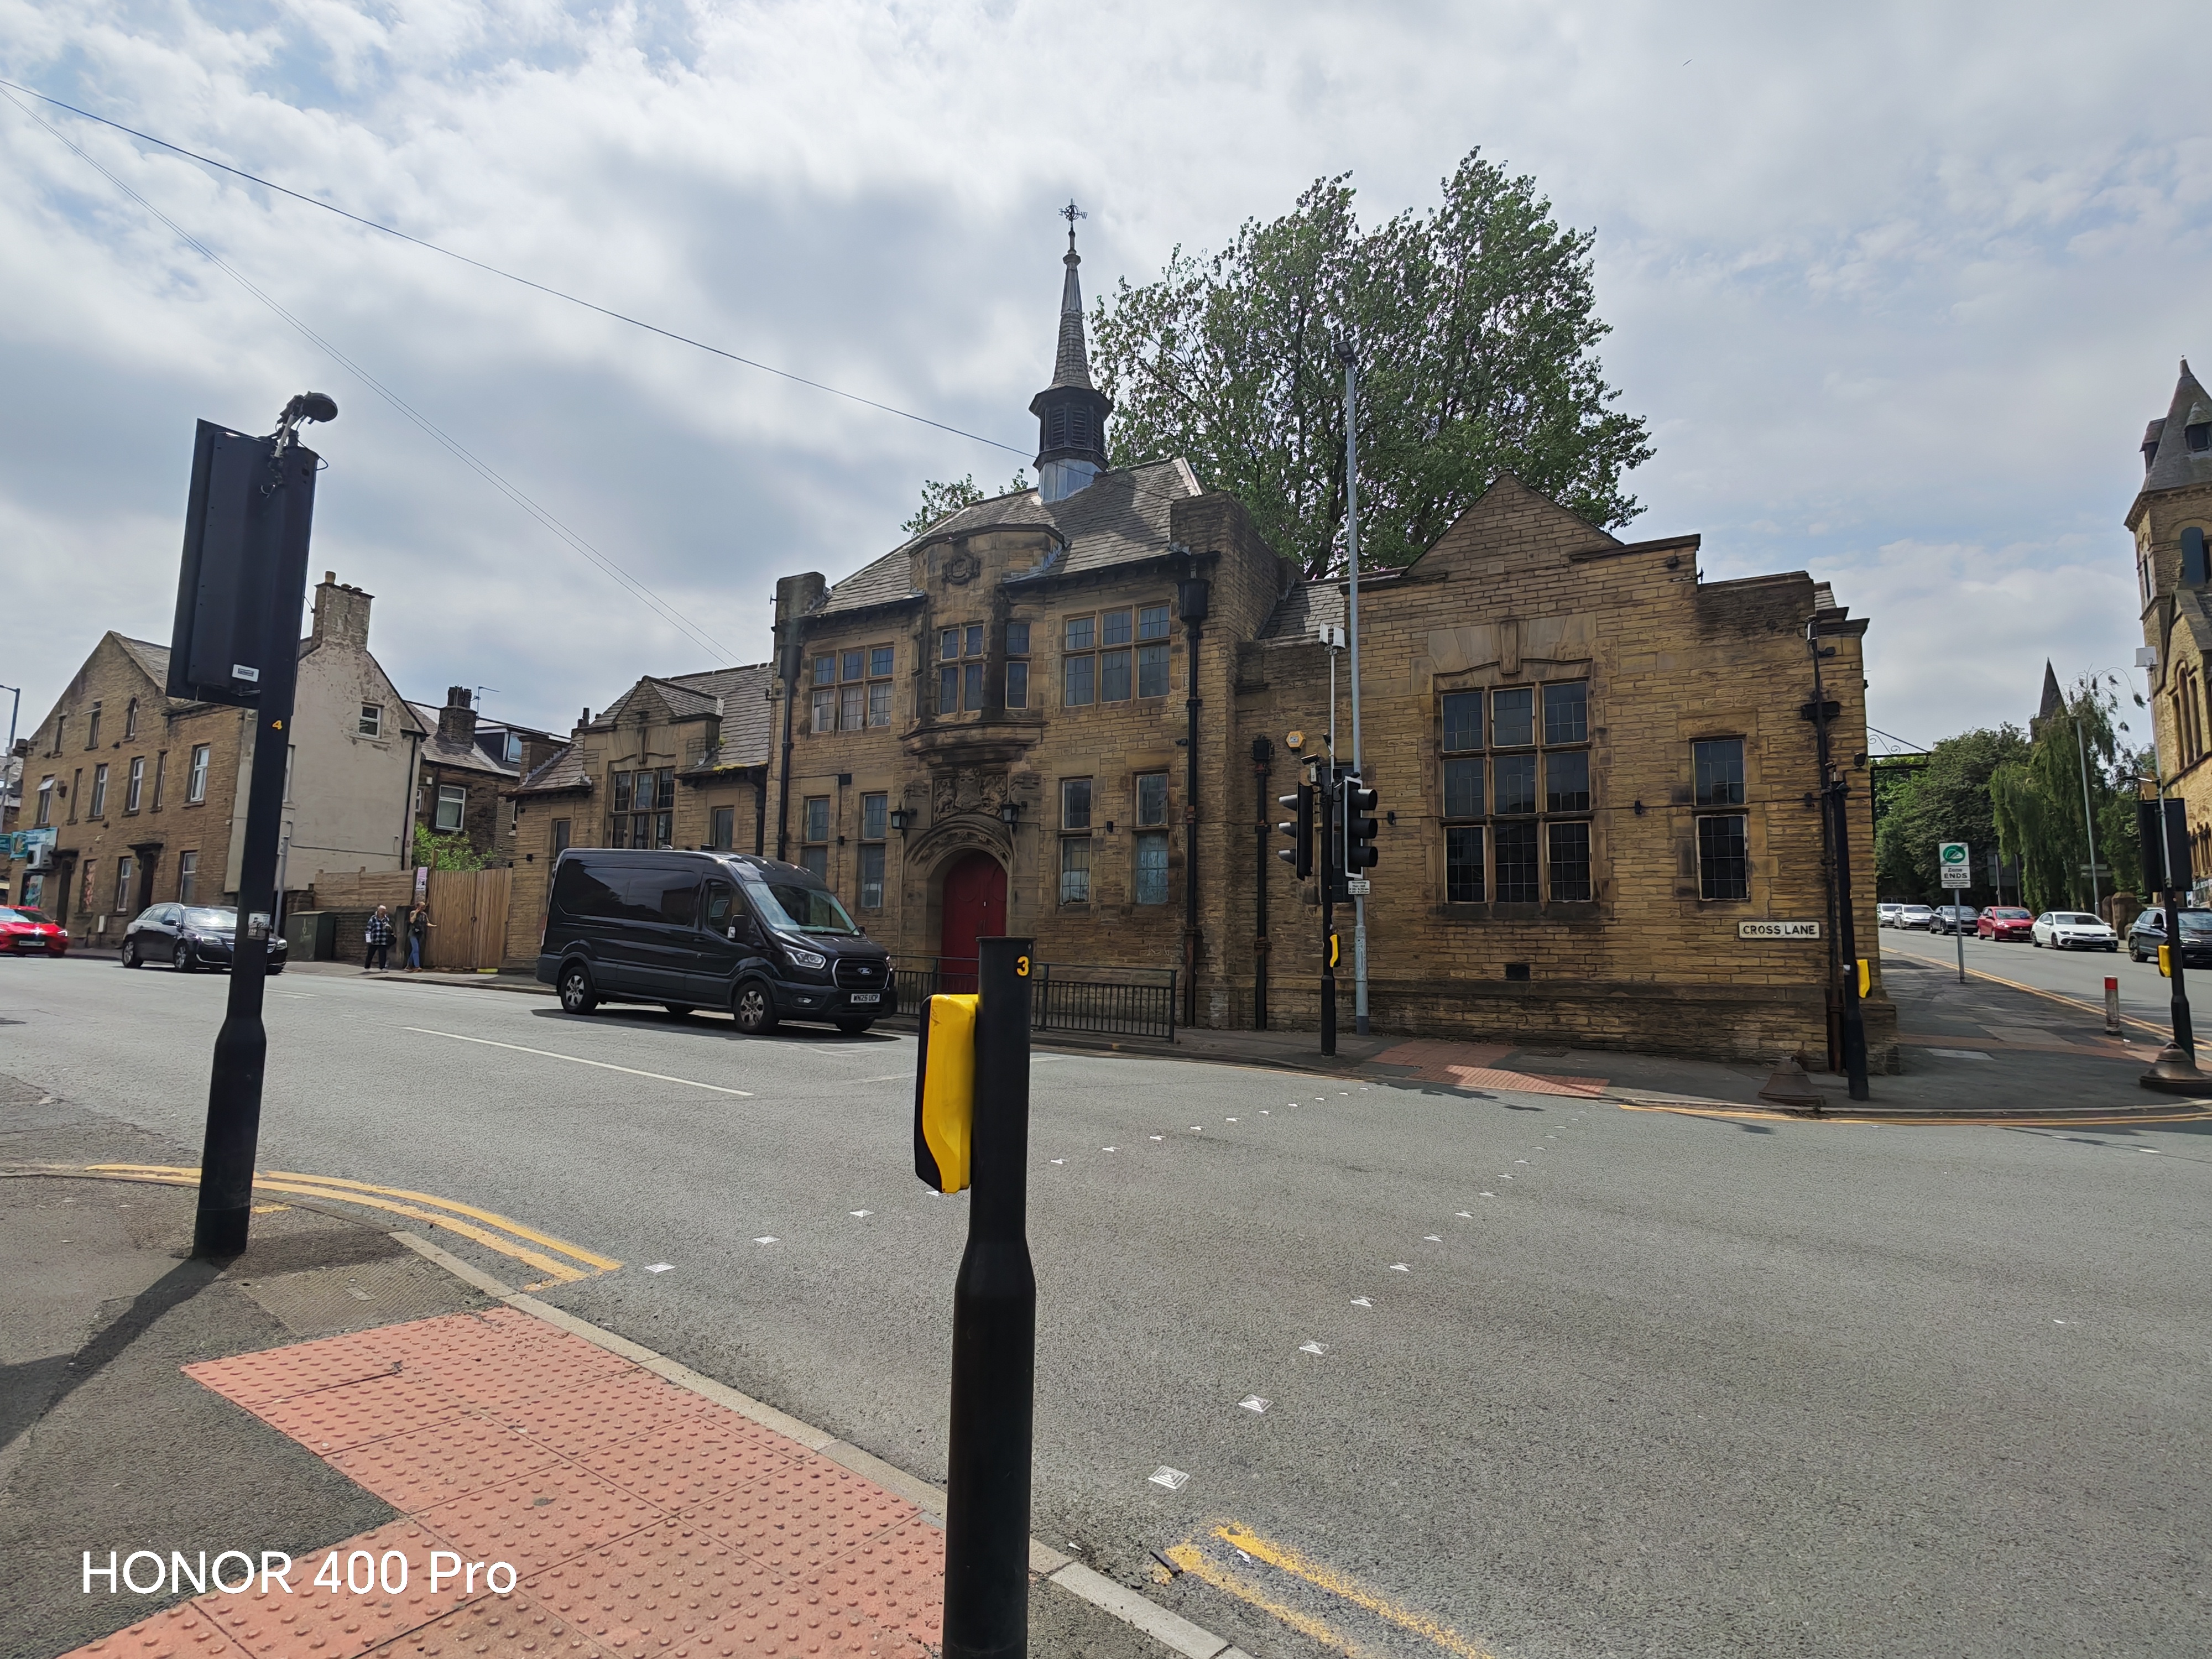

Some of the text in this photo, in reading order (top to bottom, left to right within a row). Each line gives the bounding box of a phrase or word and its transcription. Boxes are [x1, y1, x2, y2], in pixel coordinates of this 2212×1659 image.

[273, 720, 282, 729] 4
[1743, 925, 1817, 935] CROSS LANE
[1017, 956, 1029, 976] 3
